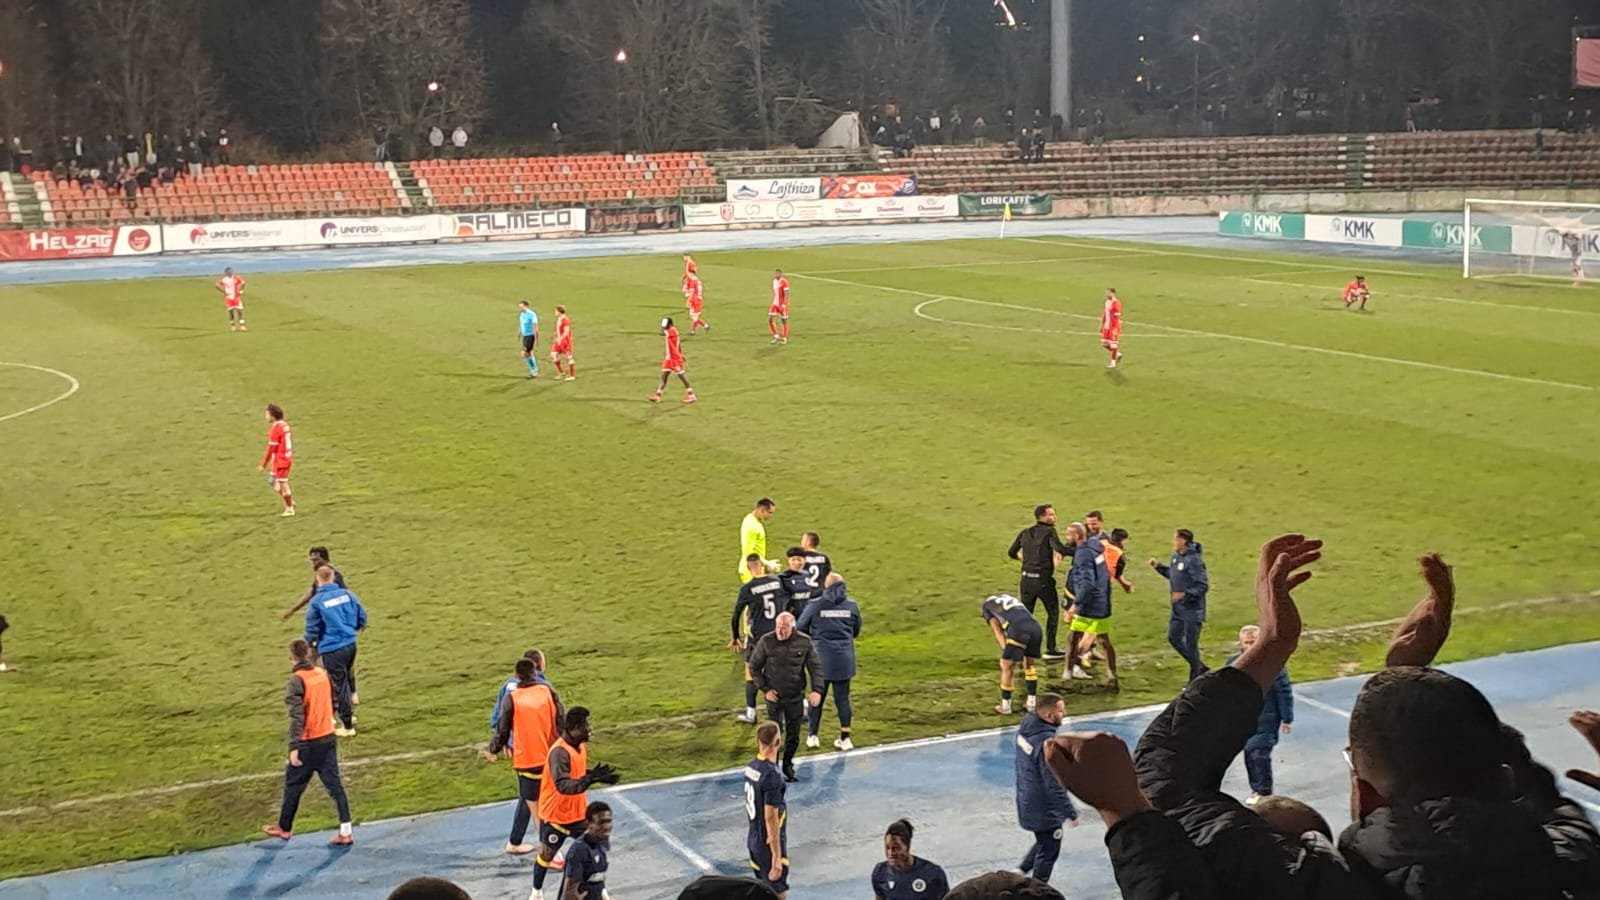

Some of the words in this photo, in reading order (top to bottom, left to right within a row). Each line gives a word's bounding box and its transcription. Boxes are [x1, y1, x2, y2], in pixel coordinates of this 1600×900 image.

[476, 210, 571, 231] ALMECO
[1254, 215, 1282, 233] KMK
[1344, 220, 1375, 240] KMK
[30, 231, 113, 251] HELZAG
[762, 593, 776, 620] 5
